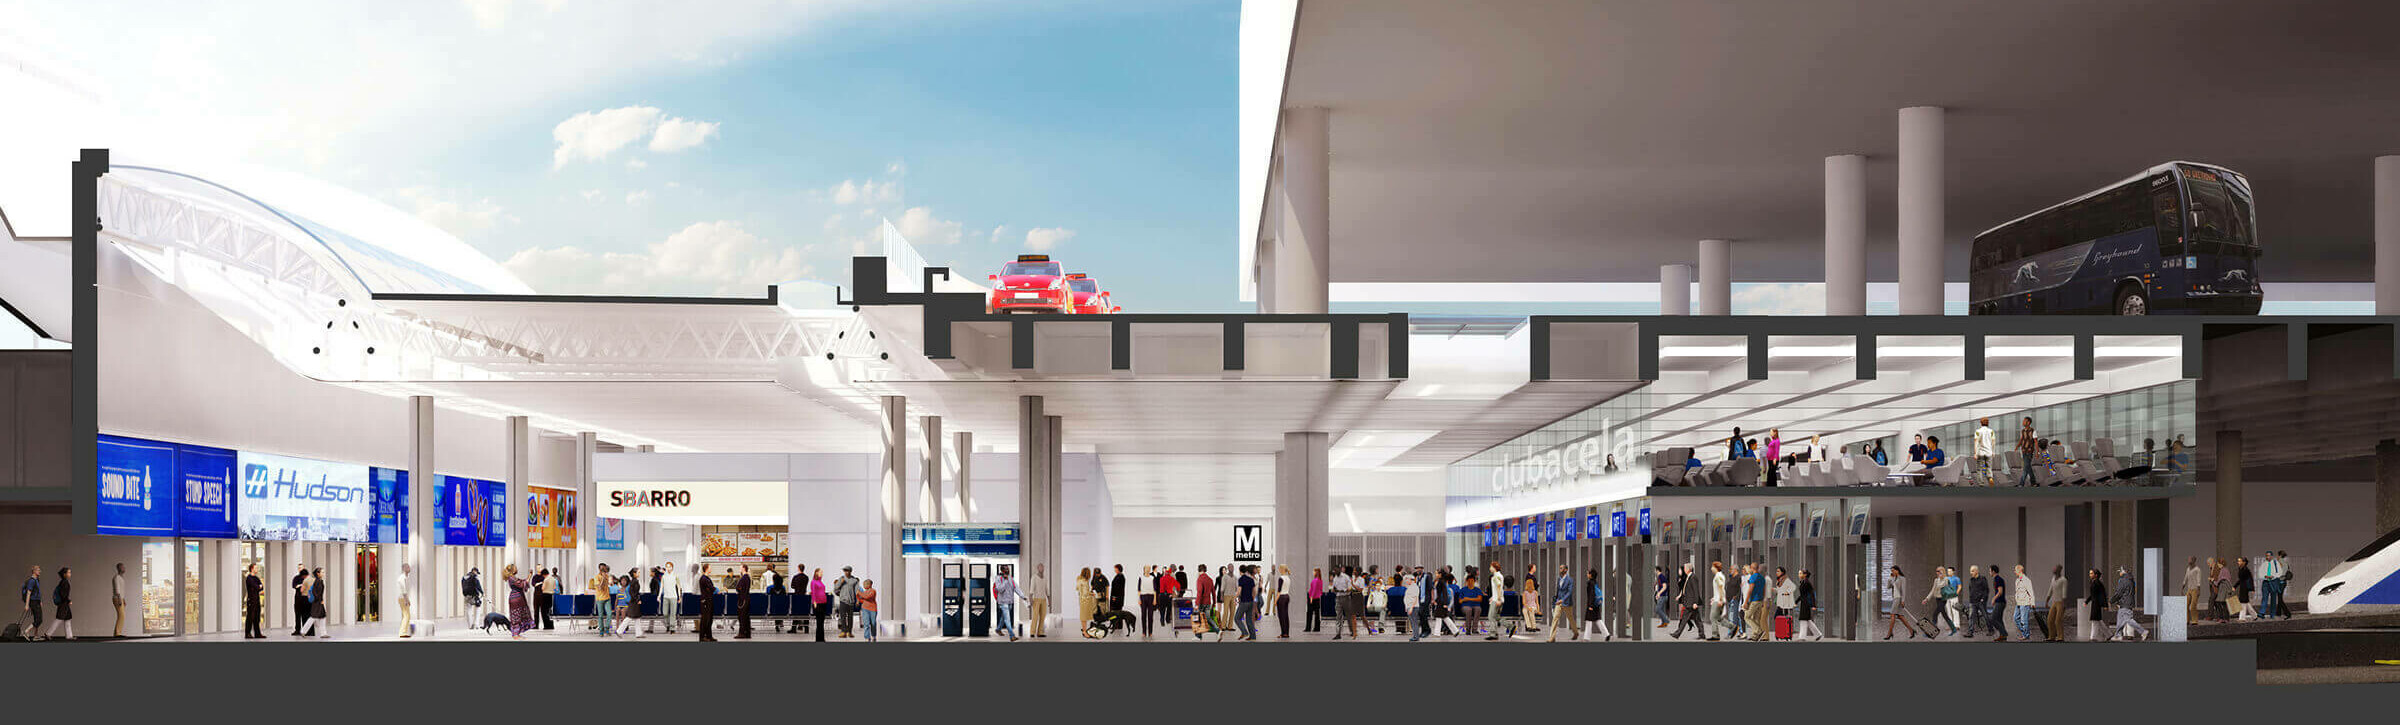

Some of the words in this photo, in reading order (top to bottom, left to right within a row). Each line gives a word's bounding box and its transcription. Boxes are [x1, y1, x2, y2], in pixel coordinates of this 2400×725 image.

[2092, 243, 2143, 267] Greyhound
[101, 472, 125, 500] SOUND
[125, 473, 141, 501] BITE
[273, 467, 365, 504] Hudson
[610, 489, 692, 508] SBARRO
[1236, 527, 1260, 551] M
[1235, 551, 1261, 559] metro
